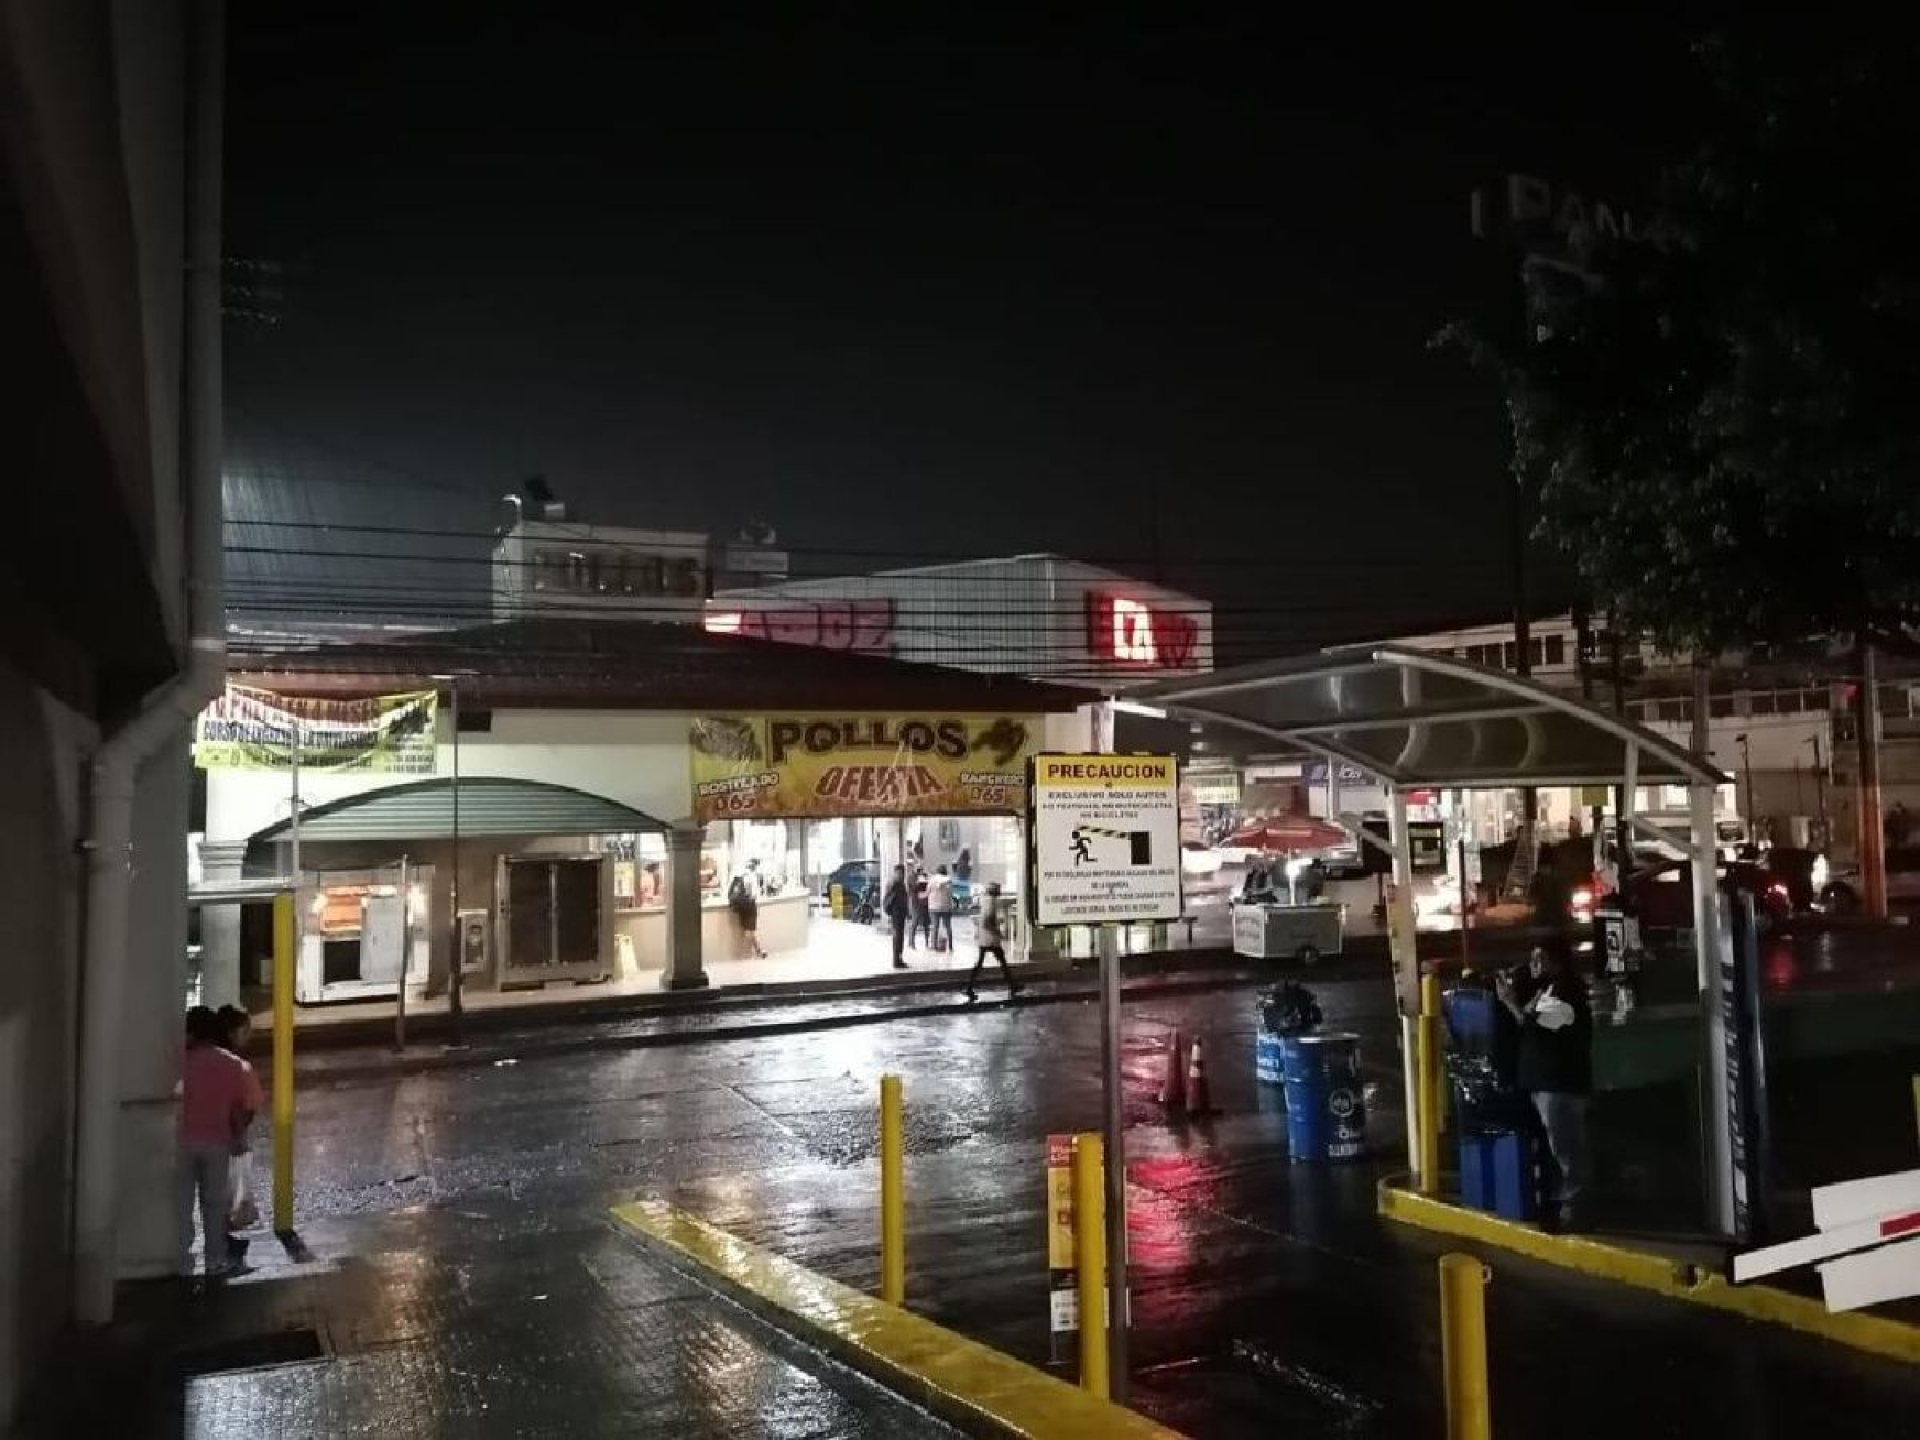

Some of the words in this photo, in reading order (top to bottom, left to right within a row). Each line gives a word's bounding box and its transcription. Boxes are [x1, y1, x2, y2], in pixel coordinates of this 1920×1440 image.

[771, 720, 967, 764] POLLOS
[815, 765, 945, 801] OFERTA
[1047, 764, 1166, 779] PRECAUCION
[1048, 791, 1104, 800] EXCLUSIVO
[1108, 791, 1134, 799] SOLO
[1136, 791, 1166, 799] AUTOS
